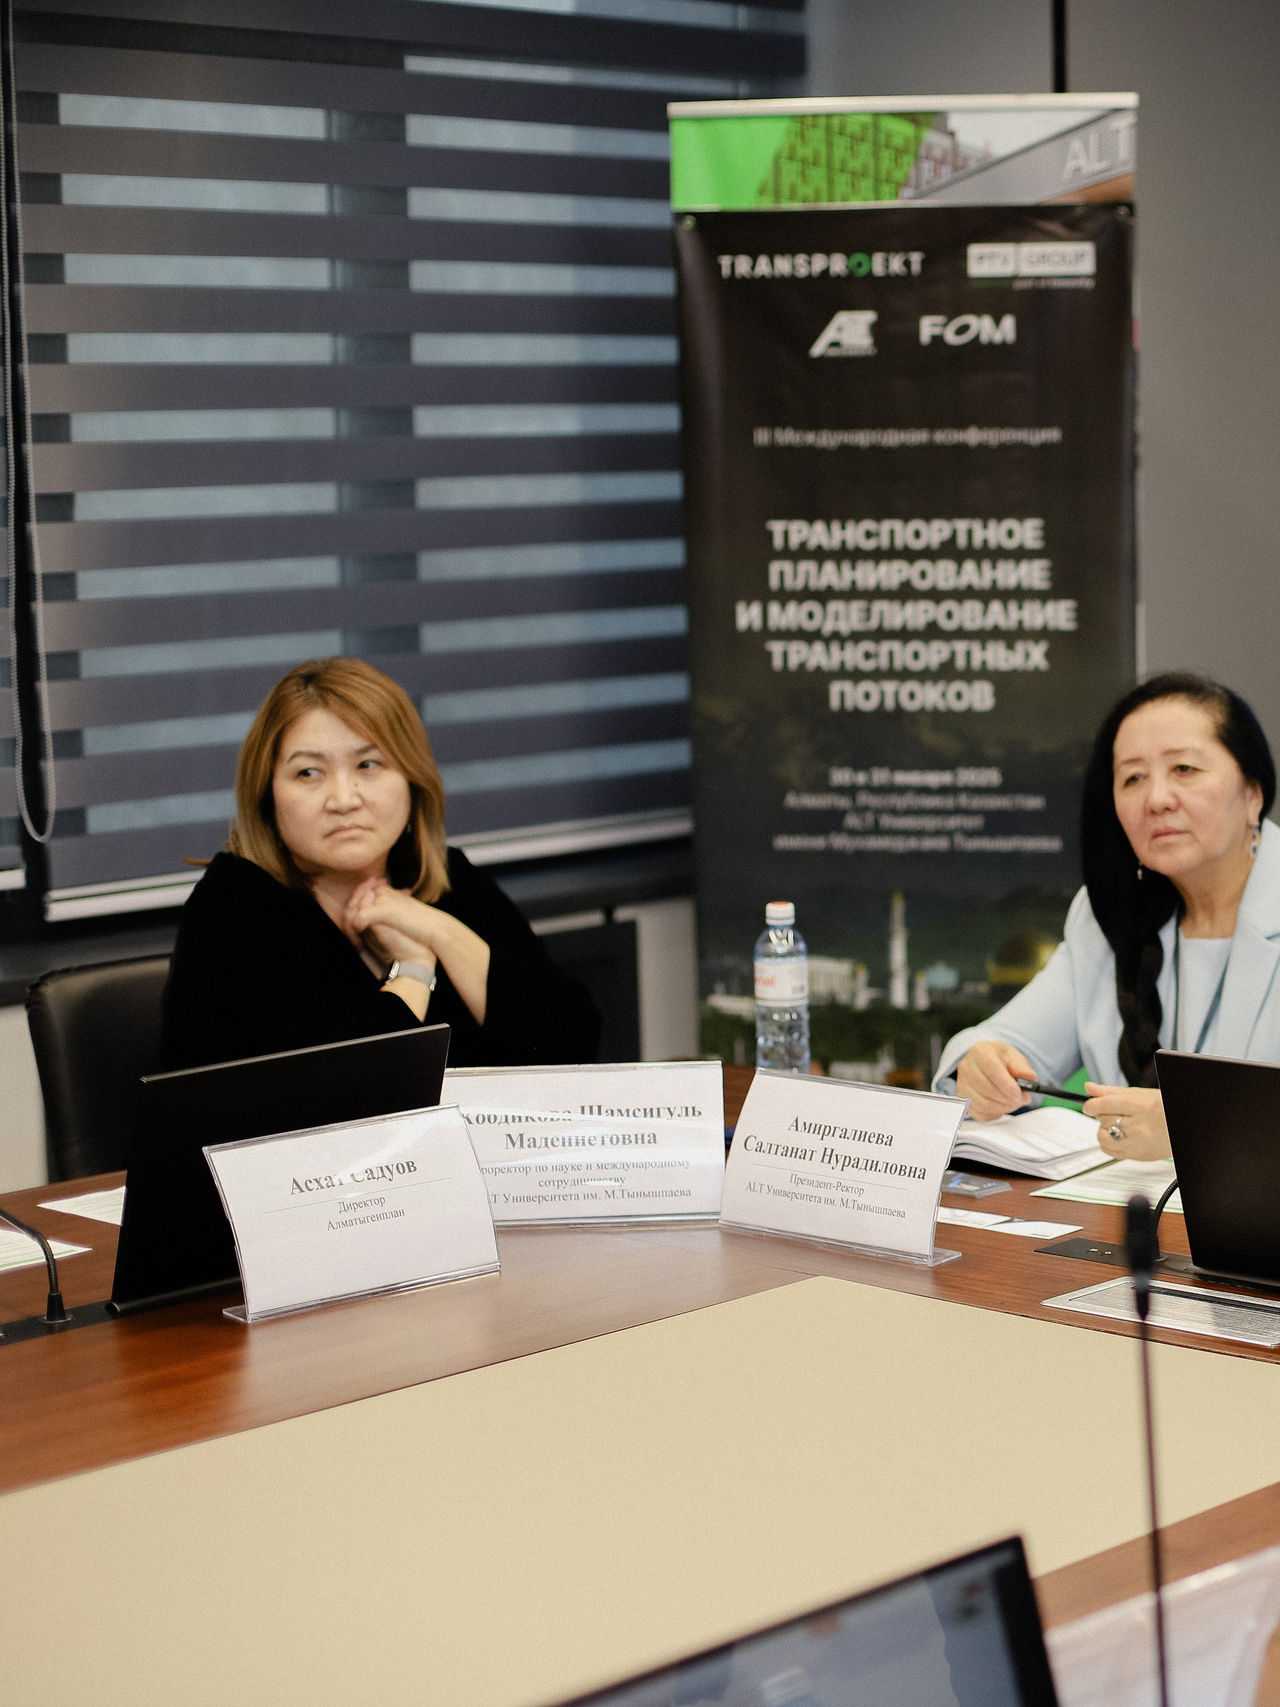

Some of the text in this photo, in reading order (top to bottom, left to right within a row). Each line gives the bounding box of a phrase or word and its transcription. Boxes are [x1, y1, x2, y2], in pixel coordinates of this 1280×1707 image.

[1064, 114, 1137, 179] ALT
[717, 252, 925, 279] TRANSPROEKT
[919, 314, 1017, 346] FOM
[773, 426, 931, 450] Международная
[932, 424, 1063, 449] конференция
[766, 518, 1045, 550] ТРАНСПОРТНОЕ
[768, 558, 1052, 591] ПЛАНИРОВАНИЕ
[735, 599, 1078, 637] И МОДЕЛИРОВАНИЕ
[765, 639, 1049, 672] ТРАНСПОРТНЫХ
[829, 680, 996, 712] ПОТОКОВ
[788, 1116, 894, 1147] Амиргалиева
[480, 1159, 690, 1177] роректор по науке и международному
[743, 1134, 927, 1181] Салтанат Нурадиловна
[503, 1192, 580, 1205] Университета
[583, 1191, 601, 1201] им.
[604, 1188, 692, 1200] М.Тынышпаева
[745, 1181, 907, 1219] ALT Университета им. М.Тынышпаева
[789, 1173, 865, 1197] Президент-Ректор
[327, 1208, 406, 1231] Алматыгенплан
[338, 1196, 386, 1214] Директор
